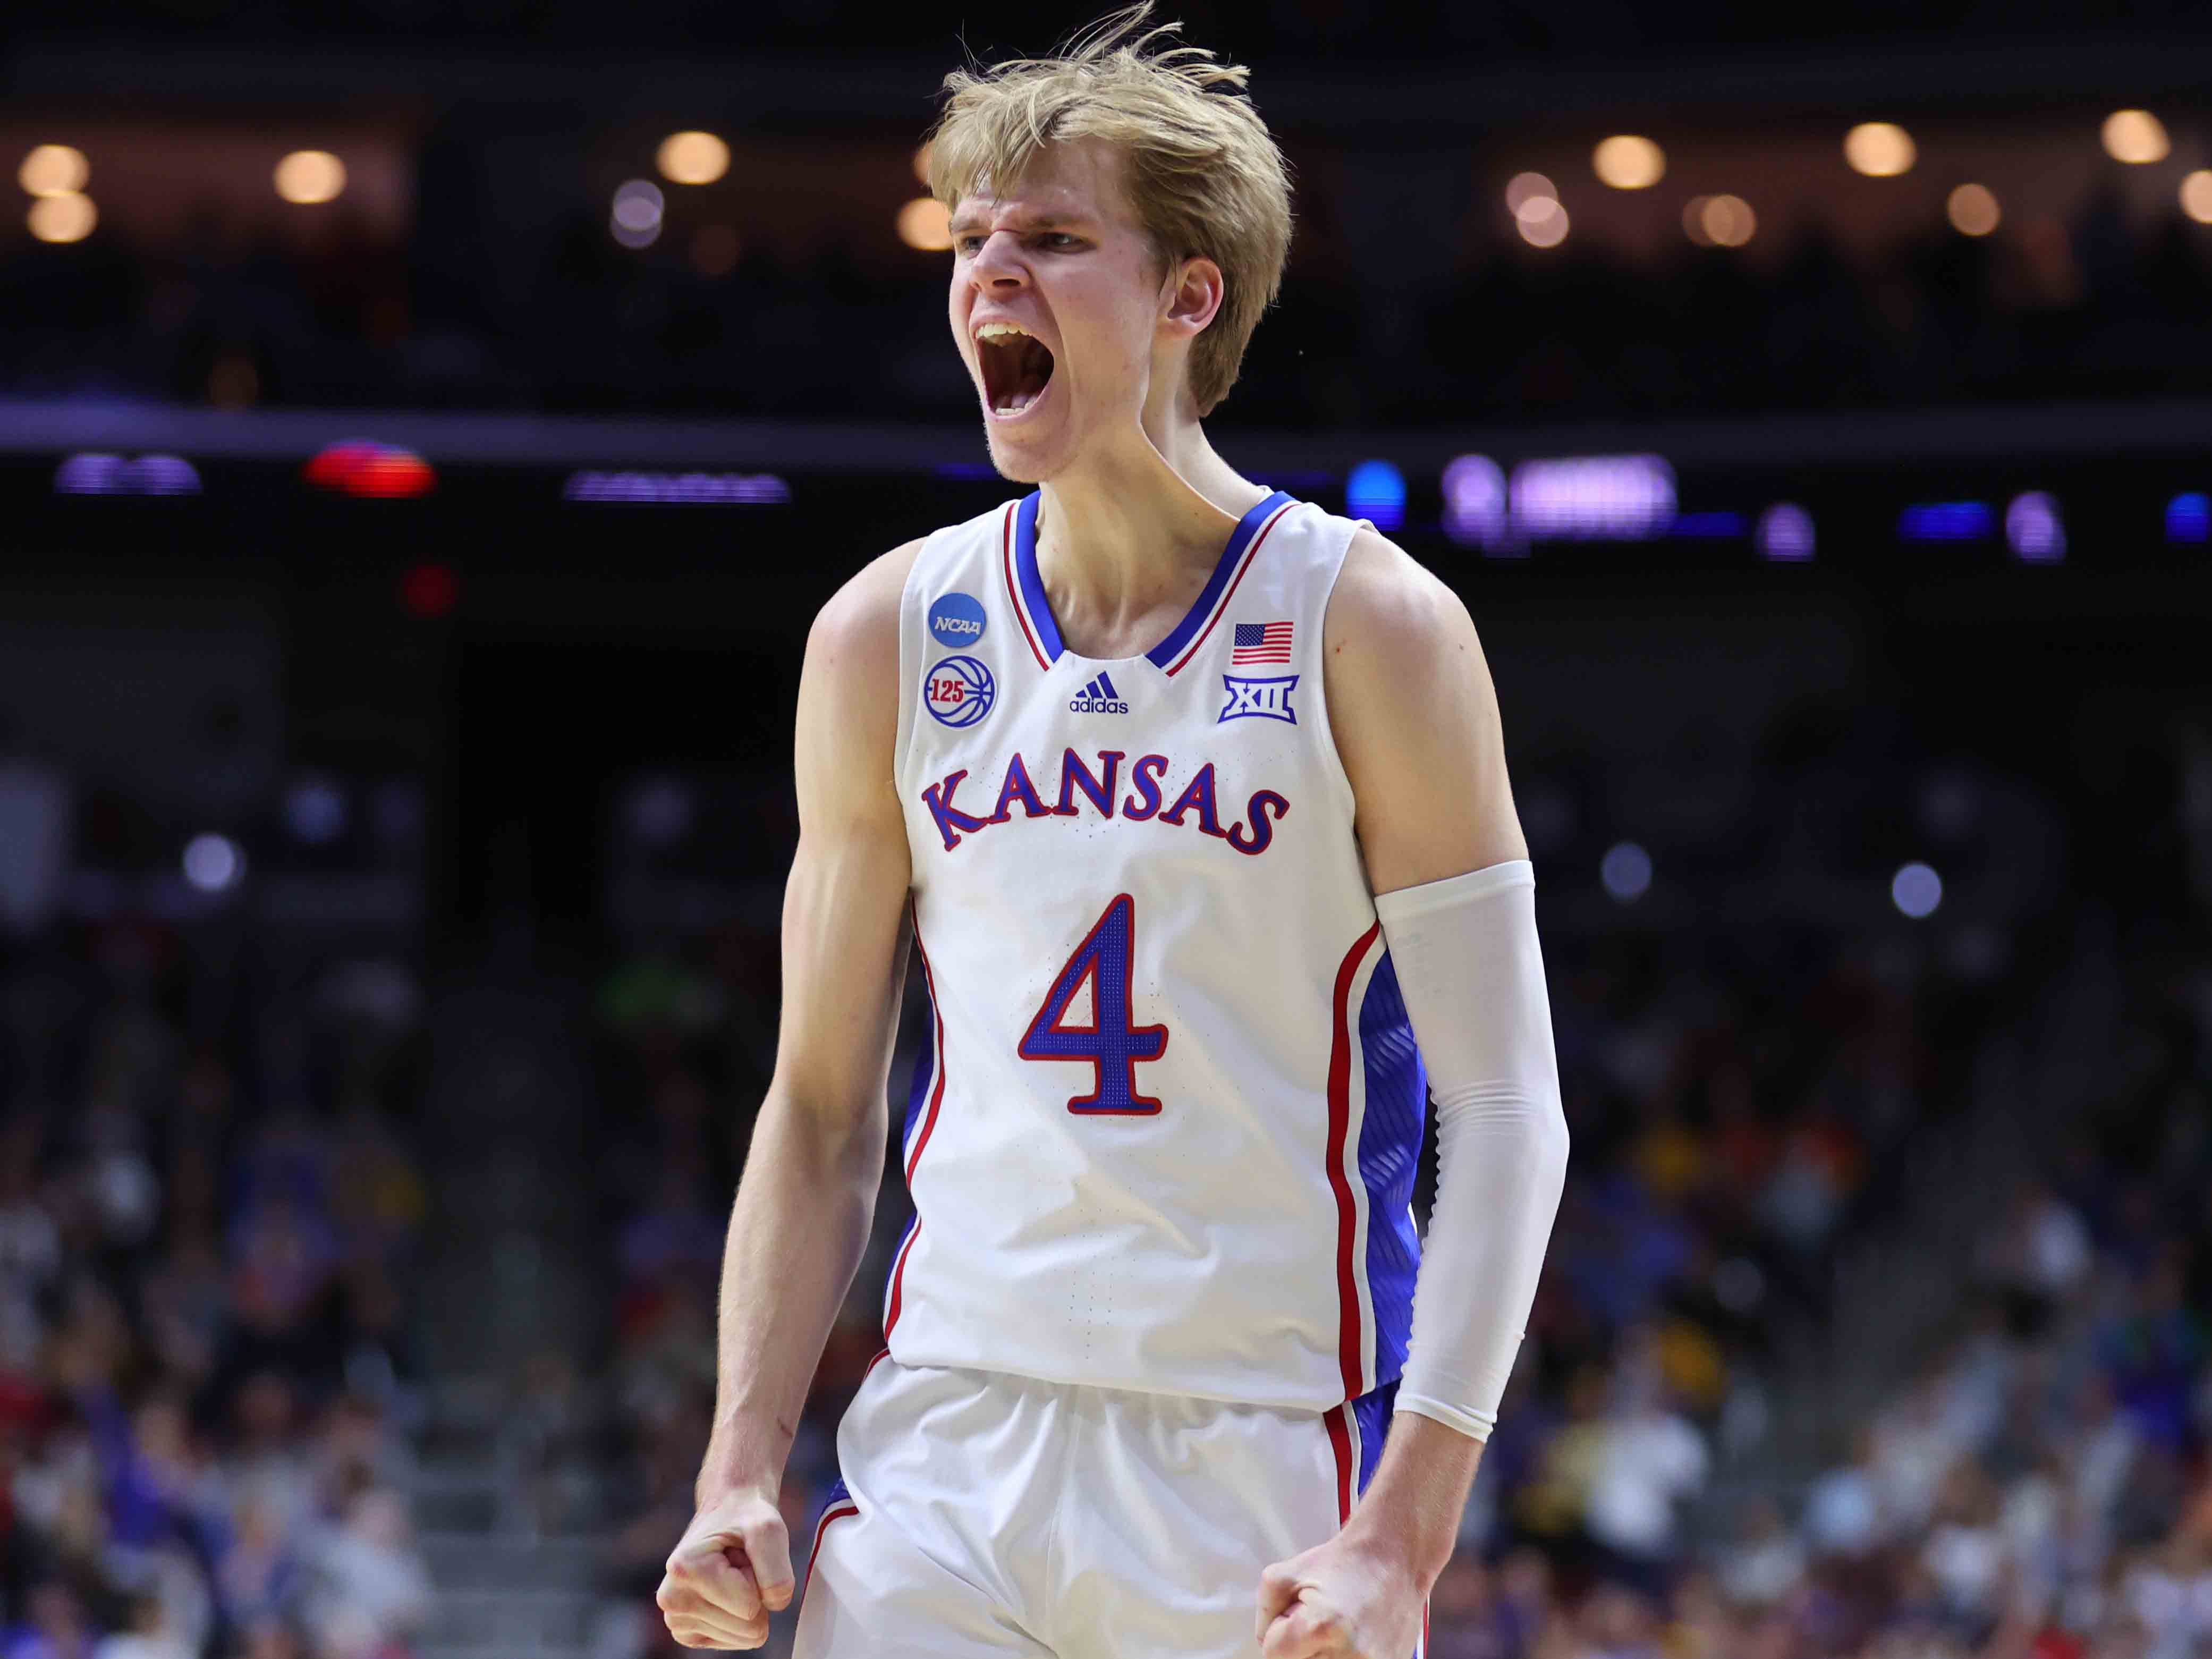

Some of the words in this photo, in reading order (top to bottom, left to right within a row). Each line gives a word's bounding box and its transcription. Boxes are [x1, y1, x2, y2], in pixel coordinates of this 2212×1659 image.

[935, 616, 981, 635] NCAA
[930, 679, 964, 702] 125
[1069, 697, 1129, 714] adidas
[921, 747, 1290, 855] KANSAS
[1018, 893, 1168, 1115] 4
